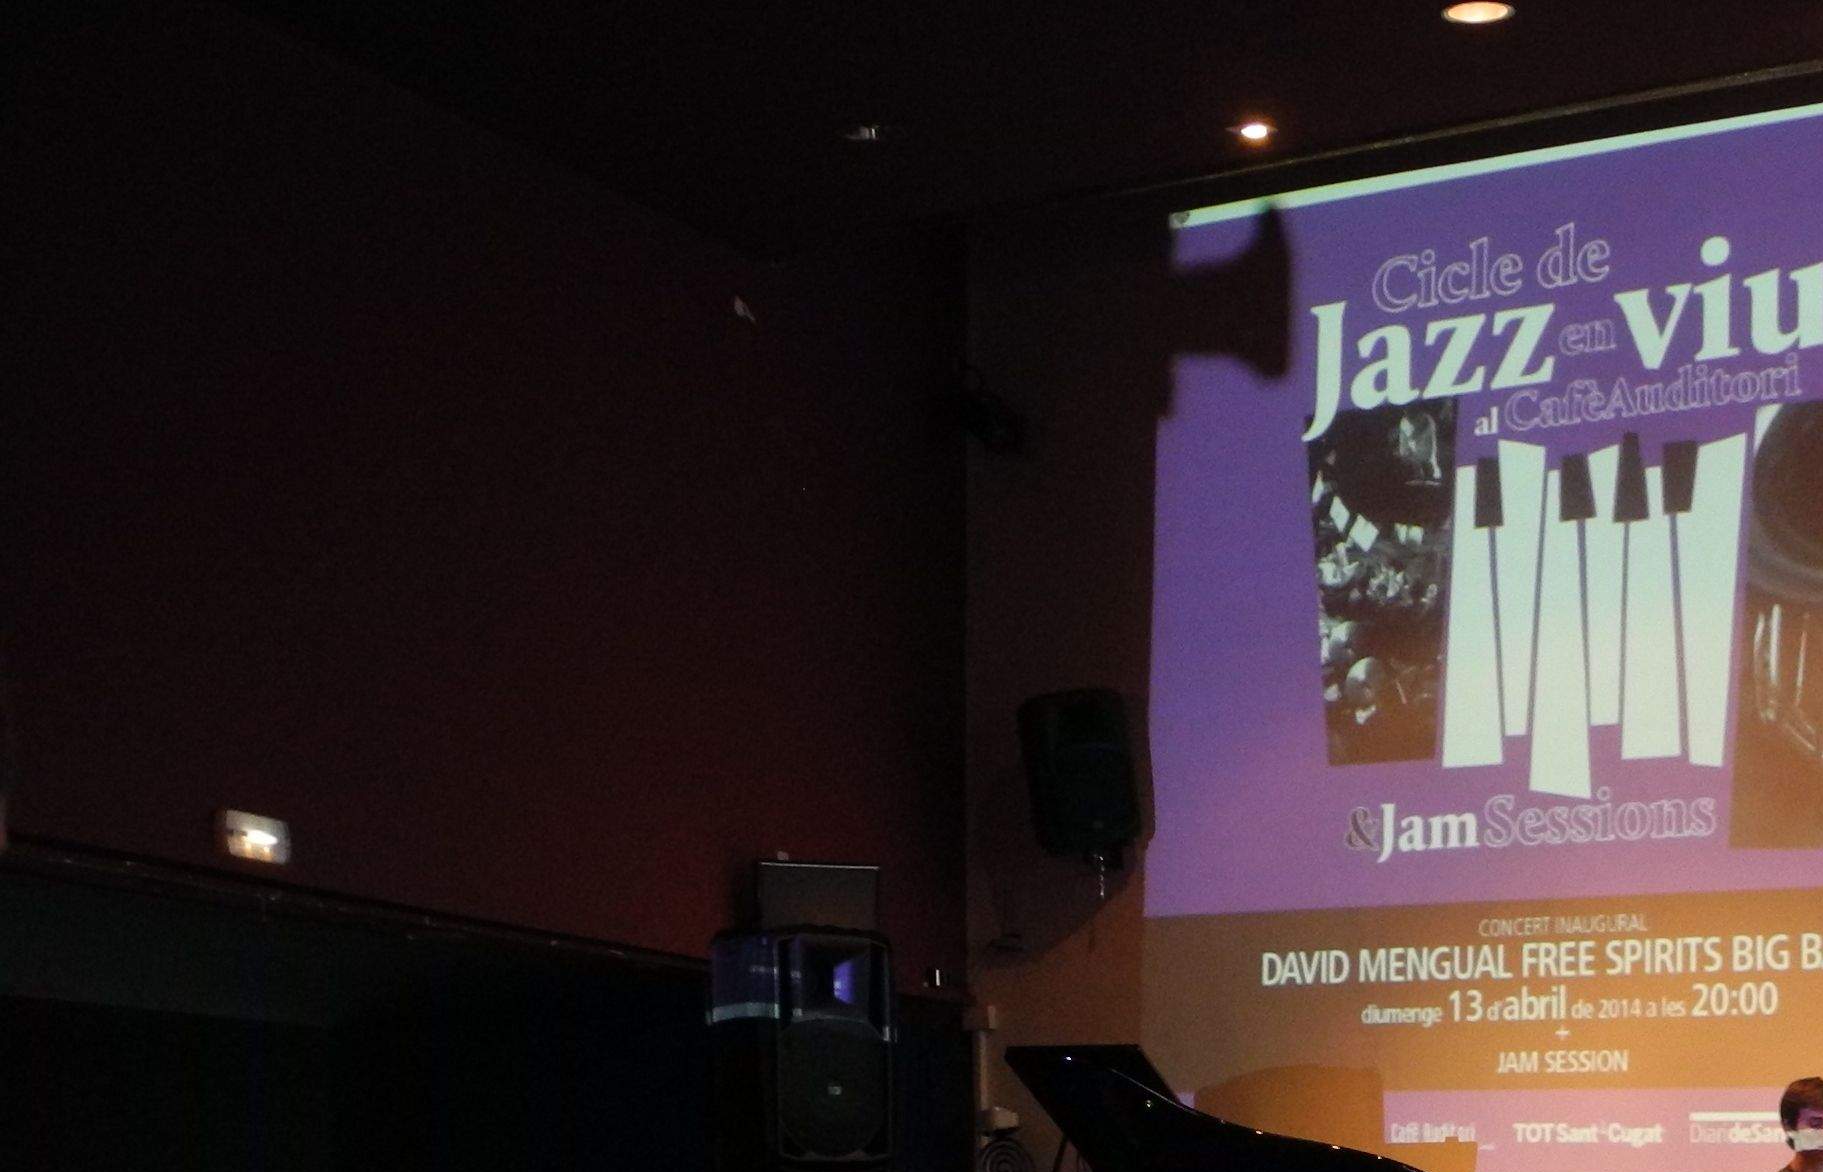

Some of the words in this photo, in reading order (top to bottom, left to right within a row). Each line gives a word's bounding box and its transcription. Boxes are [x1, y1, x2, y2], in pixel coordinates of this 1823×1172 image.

[1373, 236, 1522, 313] Cicle
[1537, 222, 1611, 288] de
[1302, 302, 1556, 441] Jazz
[1559, 316, 1616, 355] en
[1474, 410, 1499, 436] al
[1484, 785, 1716, 847] Sessions
[1478, 917, 1549, 937] CONCERT
[1556, 913, 1648, 934] INAUGURAL
[1262, 950, 1350, 986] DAVID
[1358, 944, 1513, 982] MENGUAL
[1522, 941, 1595, 978] FREE
[1605, 936, 1723, 976] SPIRITS
[1732, 933, 1790, 972] BIG
[1361, 1004, 1443, 1028] diumenge
[1450, 989, 1483, 1022] 13
[1571, 999, 1594, 1019] de
[1599, 999, 1642, 1019] 2014
[1646, 1002, 1658, 1018] a
[1661, 997, 1686, 1018] les
[1692, 981, 1779, 1017] 20:00
[1497, 1051, 1538, 1074] JAM
[1545, 1049, 1628, 1073] SESSION
[1513, 1122, 1553, 1143] TOT
